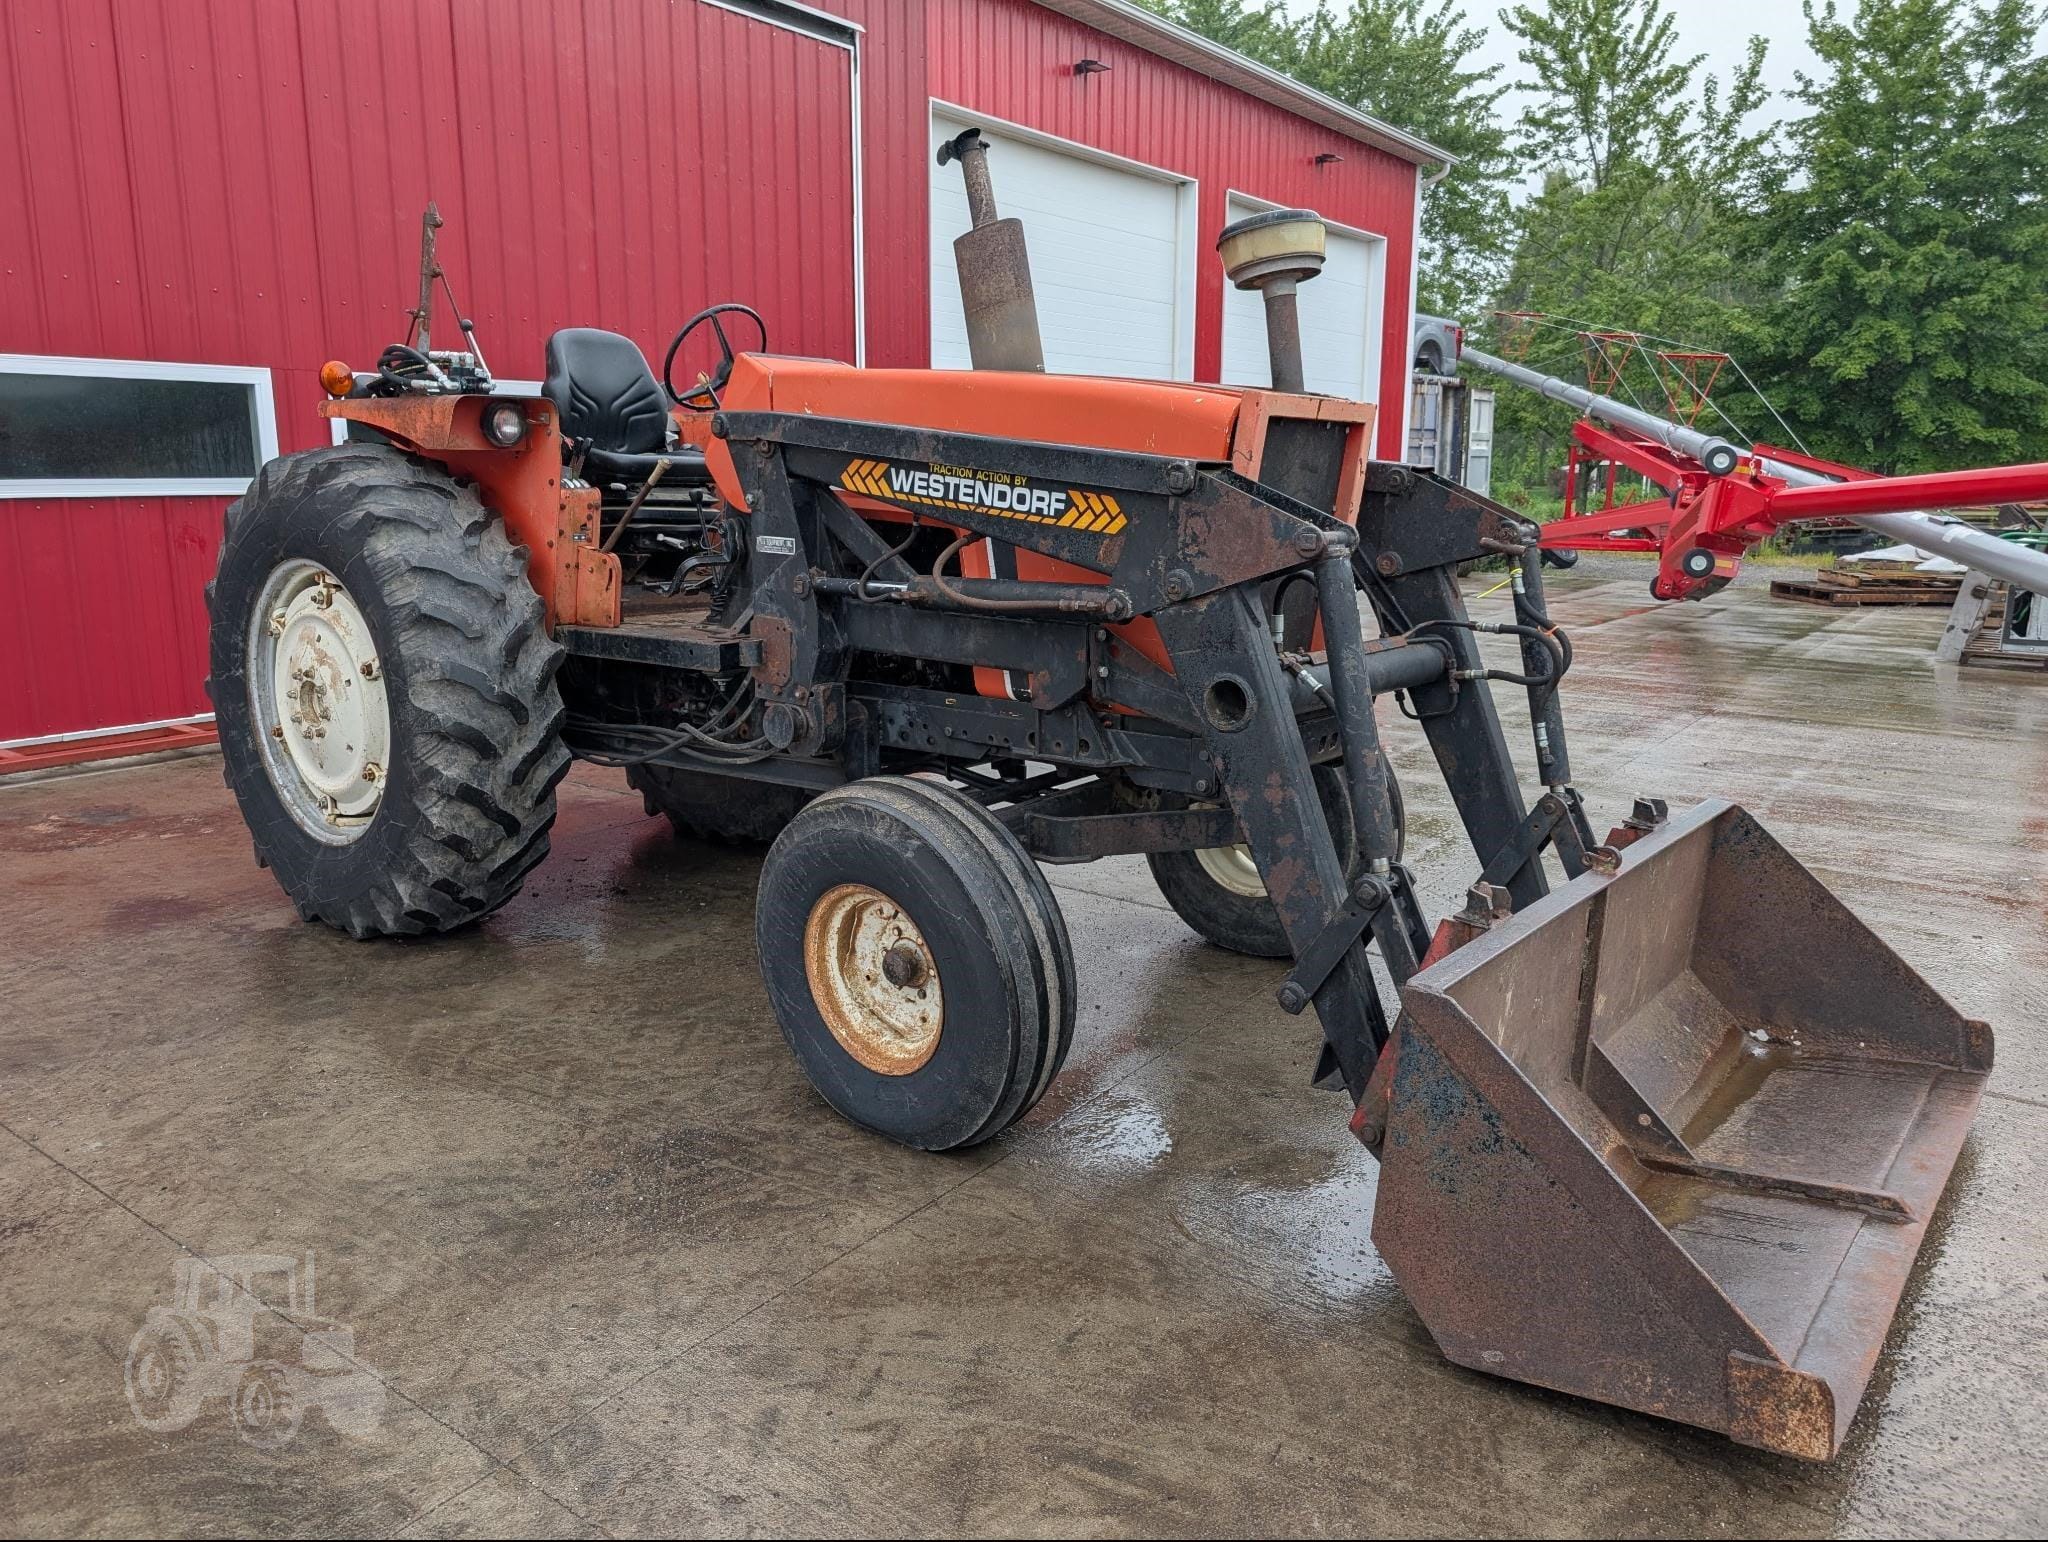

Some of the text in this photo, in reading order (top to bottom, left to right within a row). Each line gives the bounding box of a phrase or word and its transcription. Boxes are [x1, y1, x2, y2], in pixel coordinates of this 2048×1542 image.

[891, 468, 1067, 516] WESTENDORF
[929, 463, 1028, 486] TRACTION ACTION BY
